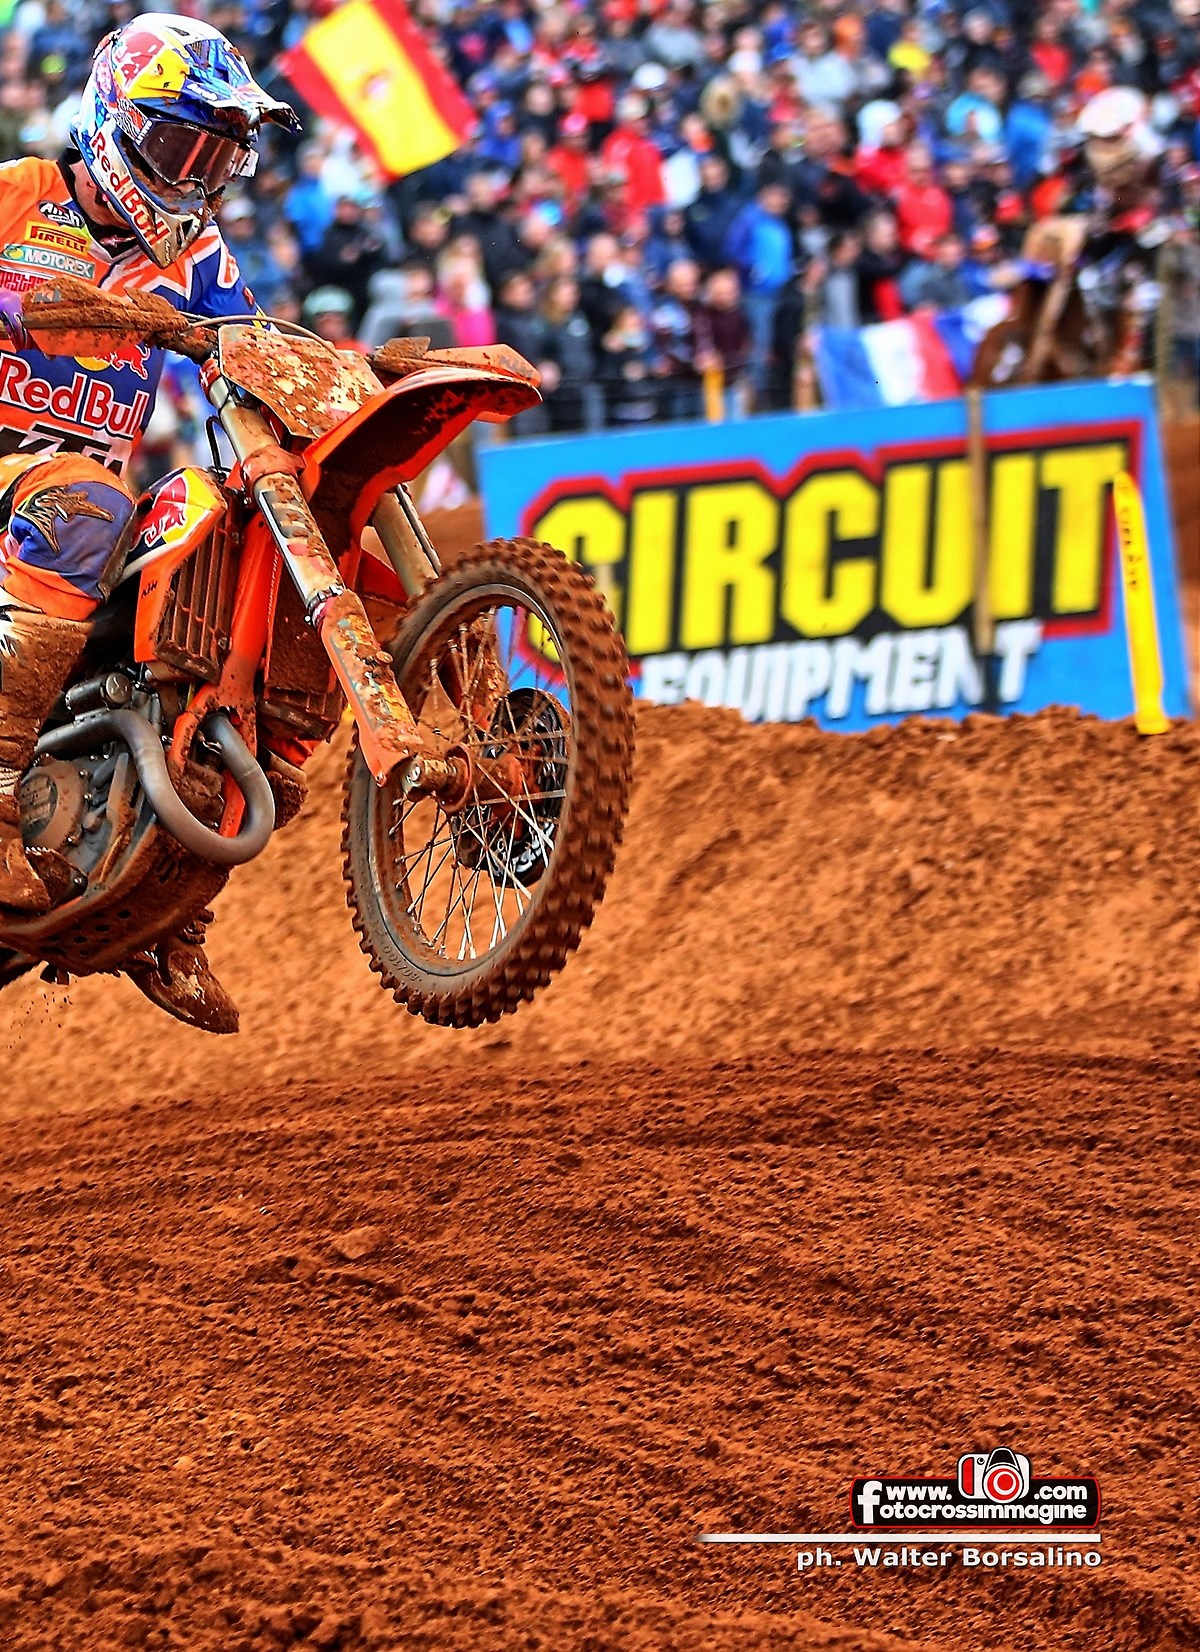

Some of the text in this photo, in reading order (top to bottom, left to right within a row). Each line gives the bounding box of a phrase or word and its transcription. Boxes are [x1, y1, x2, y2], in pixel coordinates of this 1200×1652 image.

[91, 131, 171, 247] Red Bull
[30, 226, 87, 253] PIRELLI
[24, 247, 91, 278] MOTOREX
[81, 381, 149, 435] Bull
